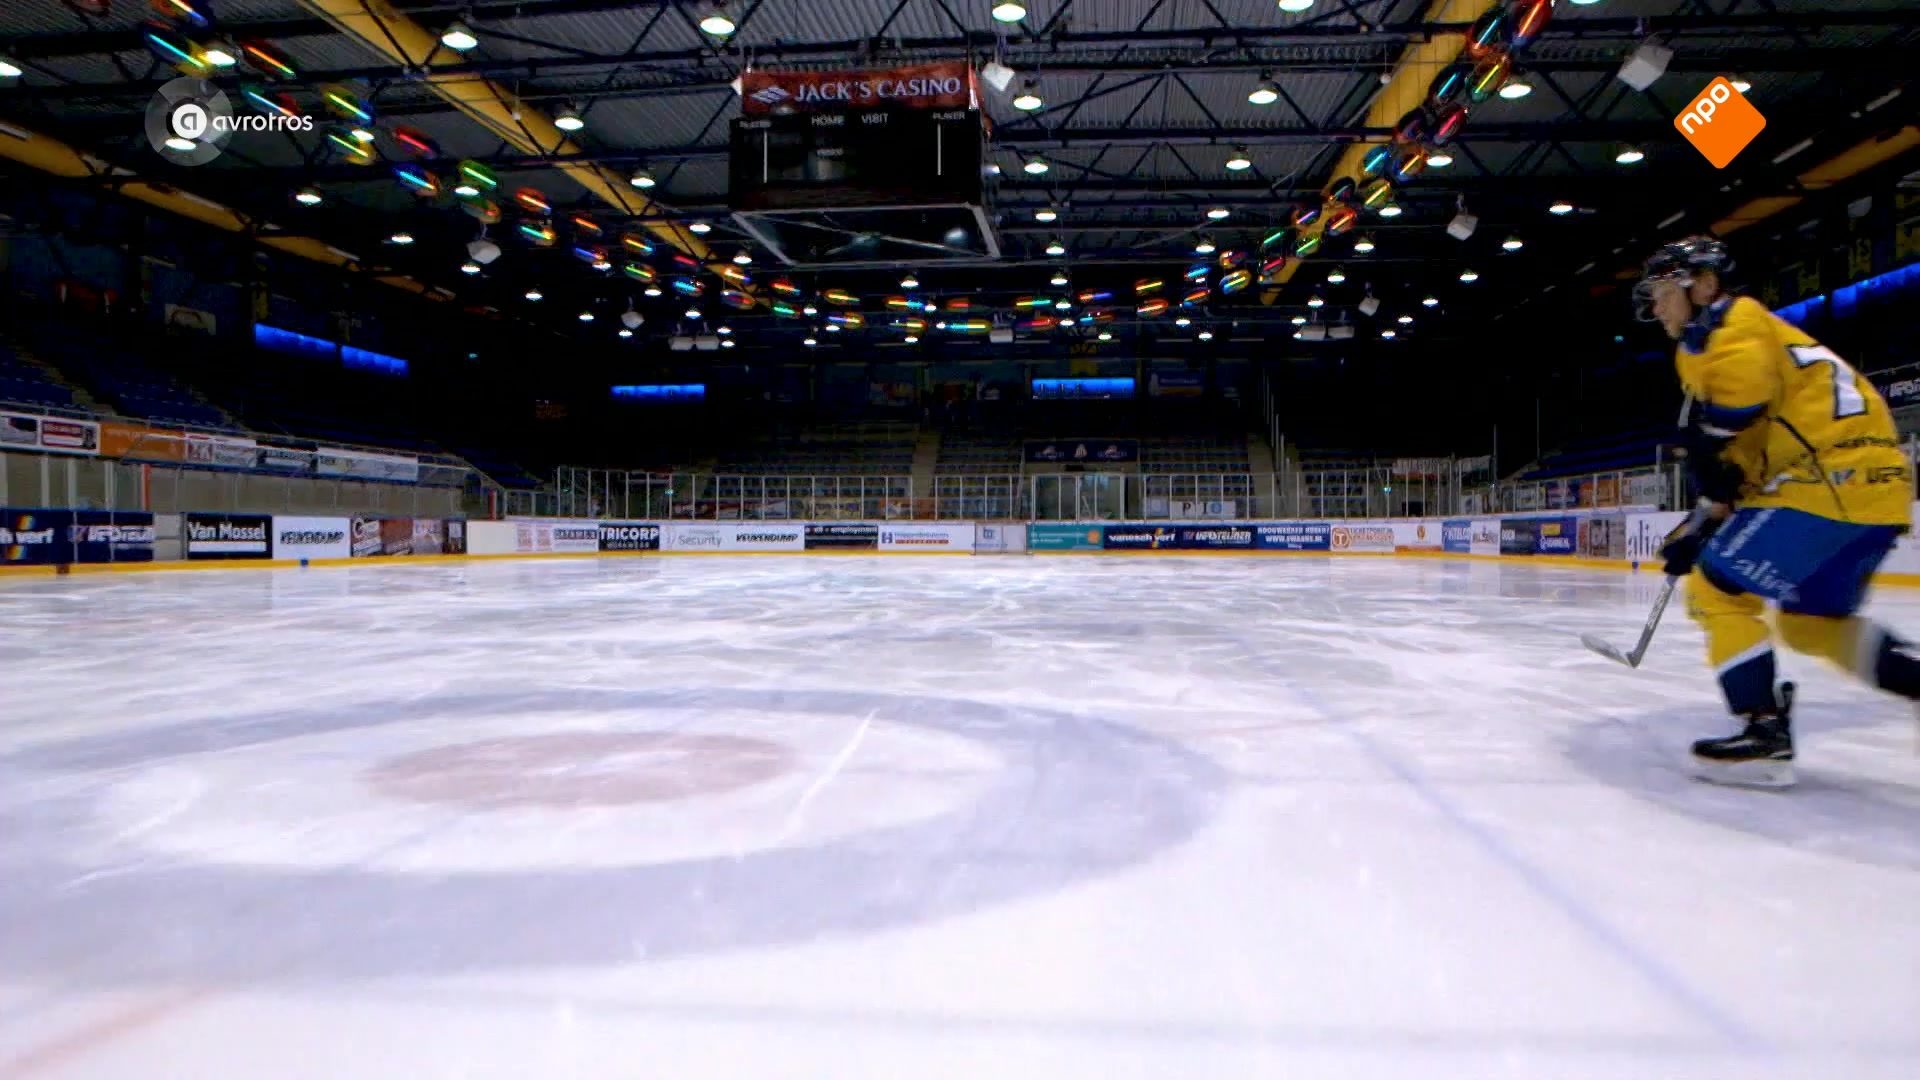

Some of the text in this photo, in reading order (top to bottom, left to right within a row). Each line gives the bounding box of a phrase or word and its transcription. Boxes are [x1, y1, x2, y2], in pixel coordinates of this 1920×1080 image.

[794, 77, 961, 102] JACK'S CASINO
[811, 114, 846, 127] HOME
[861, 112, 889, 125] VISIT
[15, 527, 54, 543] verf
[188, 521, 266, 540] Van Mossel
[600, 527, 659, 541] TRICORP
[678, 534, 722, 548] Security
